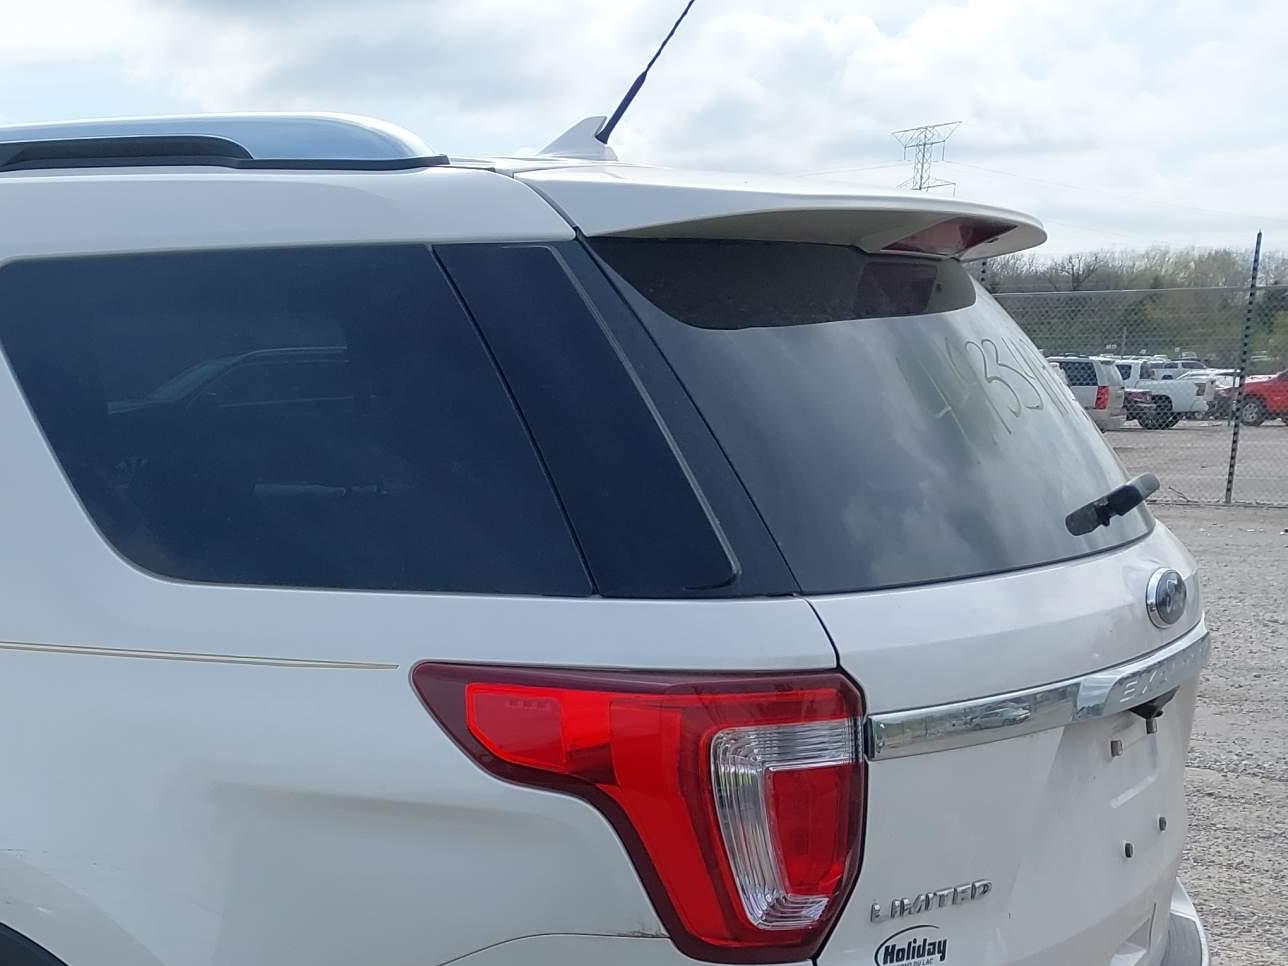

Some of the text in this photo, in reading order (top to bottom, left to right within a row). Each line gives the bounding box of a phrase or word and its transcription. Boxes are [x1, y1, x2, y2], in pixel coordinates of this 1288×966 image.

[870, 879, 992, 921] LIMITED
[882, 938, 948, 965] Holiday
[922, 958, 934, 966] LAC
